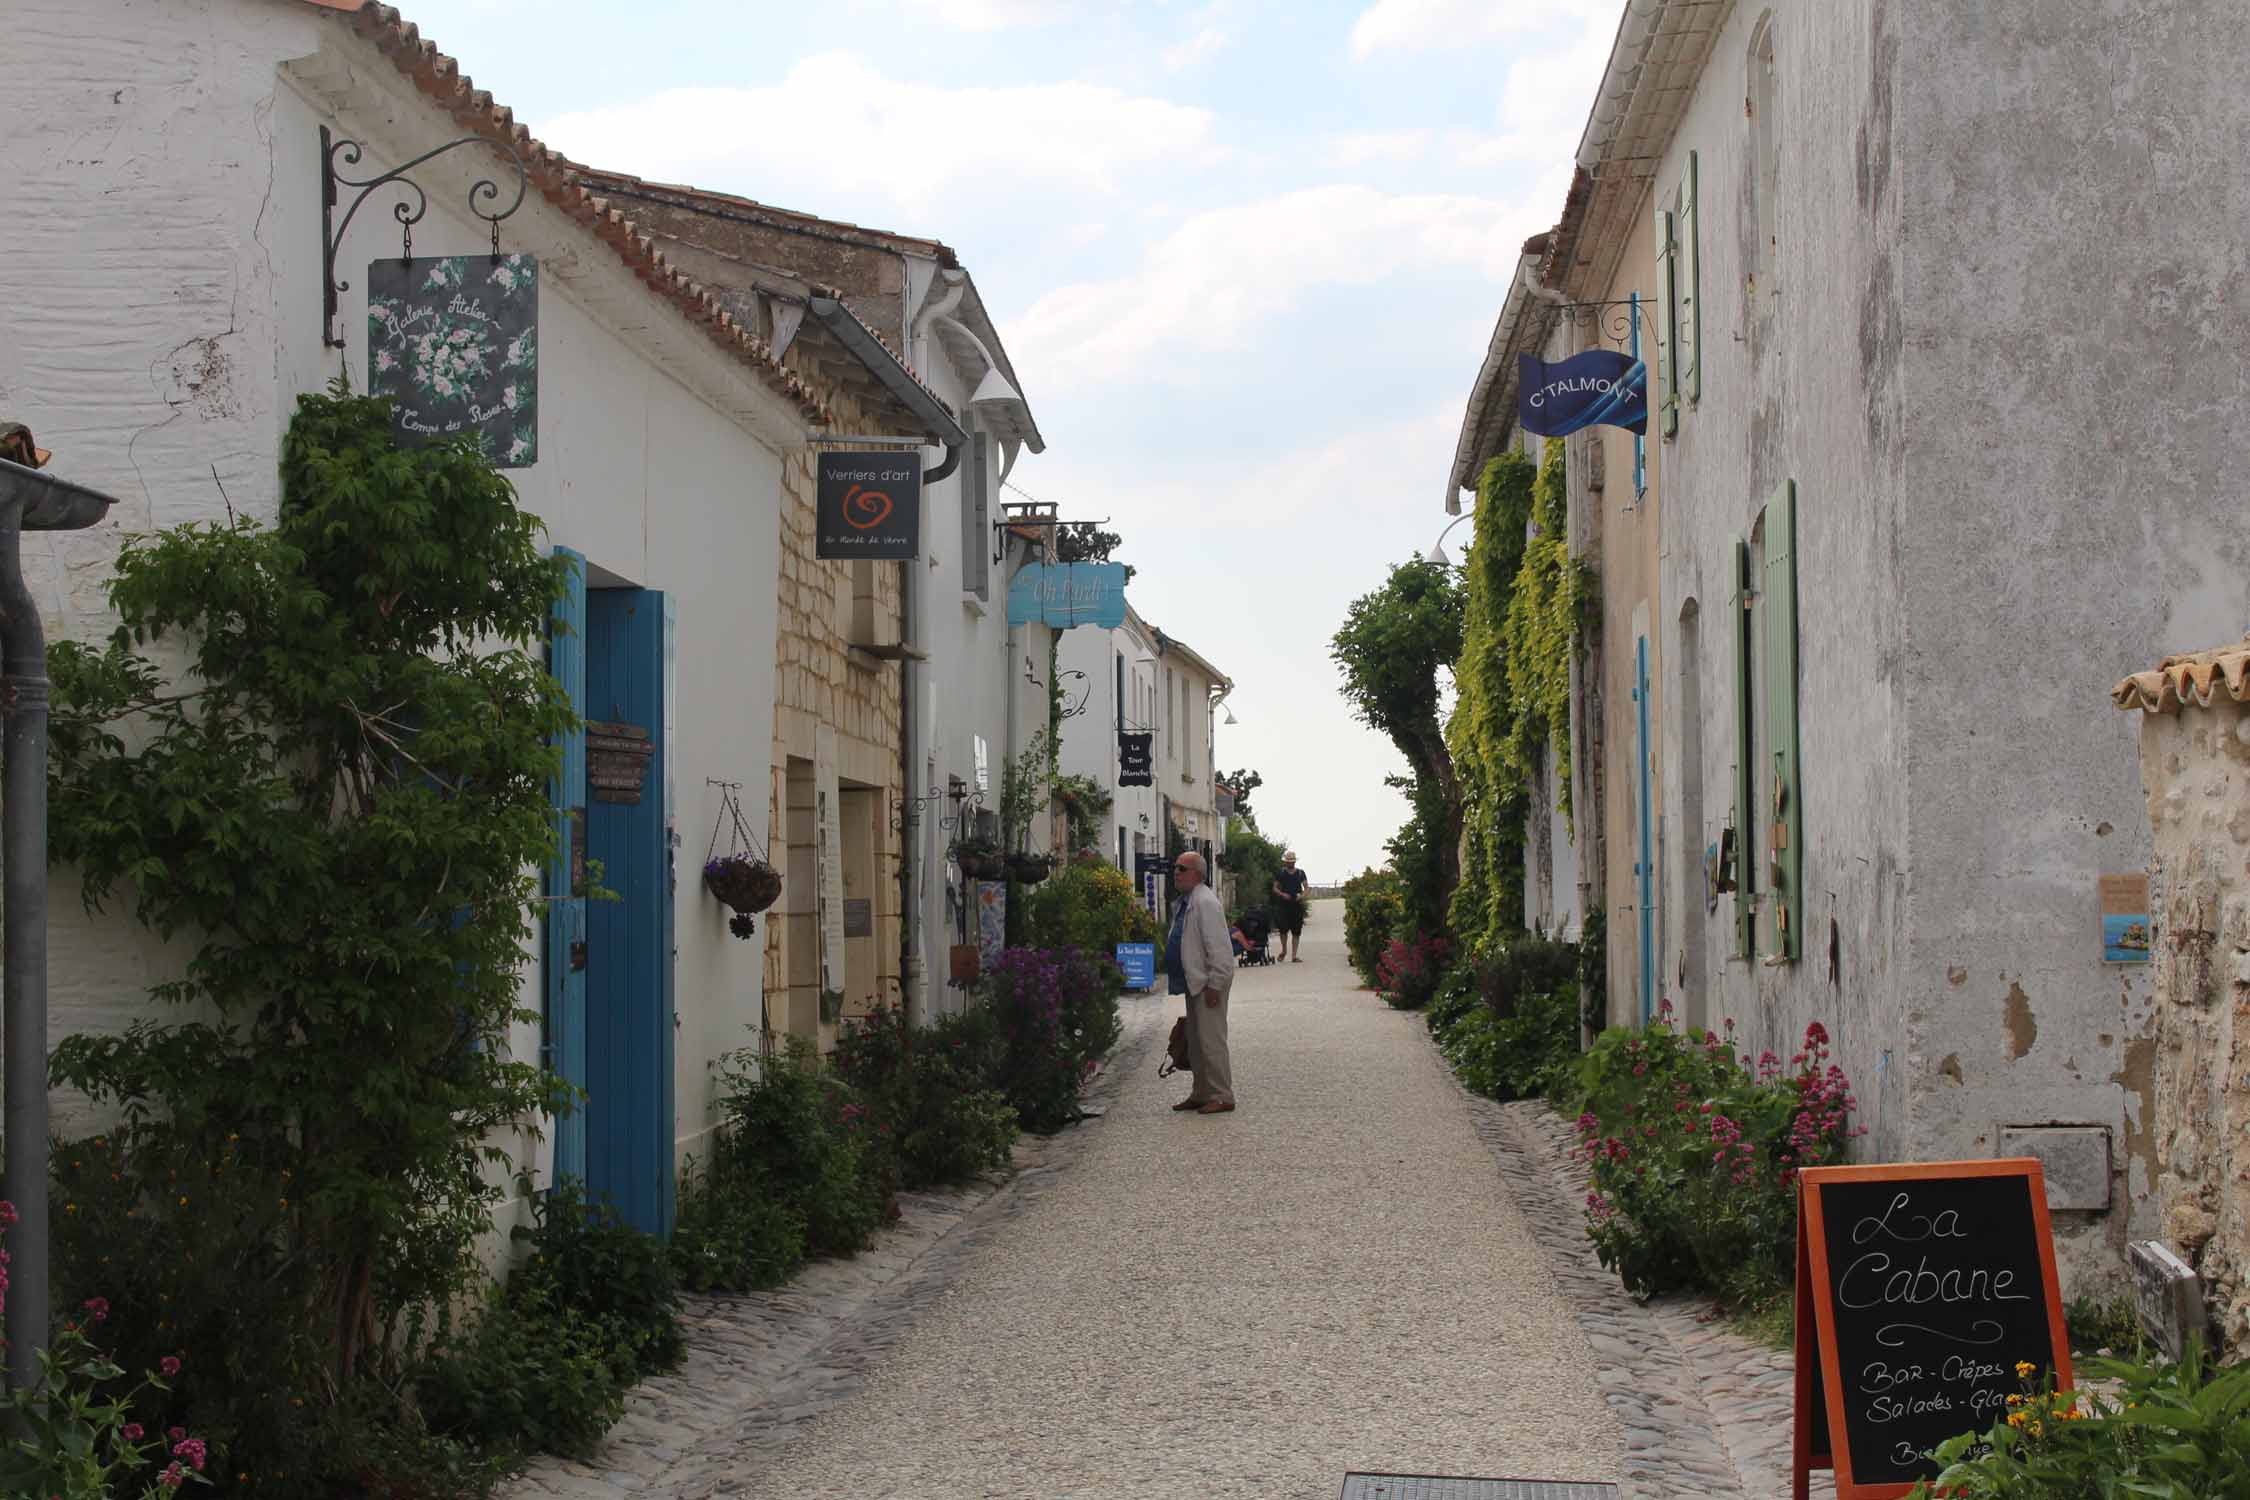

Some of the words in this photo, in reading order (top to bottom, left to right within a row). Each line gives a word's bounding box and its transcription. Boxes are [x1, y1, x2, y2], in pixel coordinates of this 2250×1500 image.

[385, 304, 434, 350] Galerie
[447, 293, 490, 322] Atelier
[1529, 377, 1638, 408] C'TALMONT
[401, 408, 439, 434] Temps
[445, 420, 461, 431] des
[826, 469, 876, 481] Verriers
[880, 469, 910, 481] d'art
[1122, 769, 1149, 777] Blanche
[1852, 1192, 1969, 1244] La
[1839, 1252, 2031, 1309] Cabane
[1942, 1355, 2005, 1388] Crêpes
[1866, 1391, 1953, 1423] Salades
